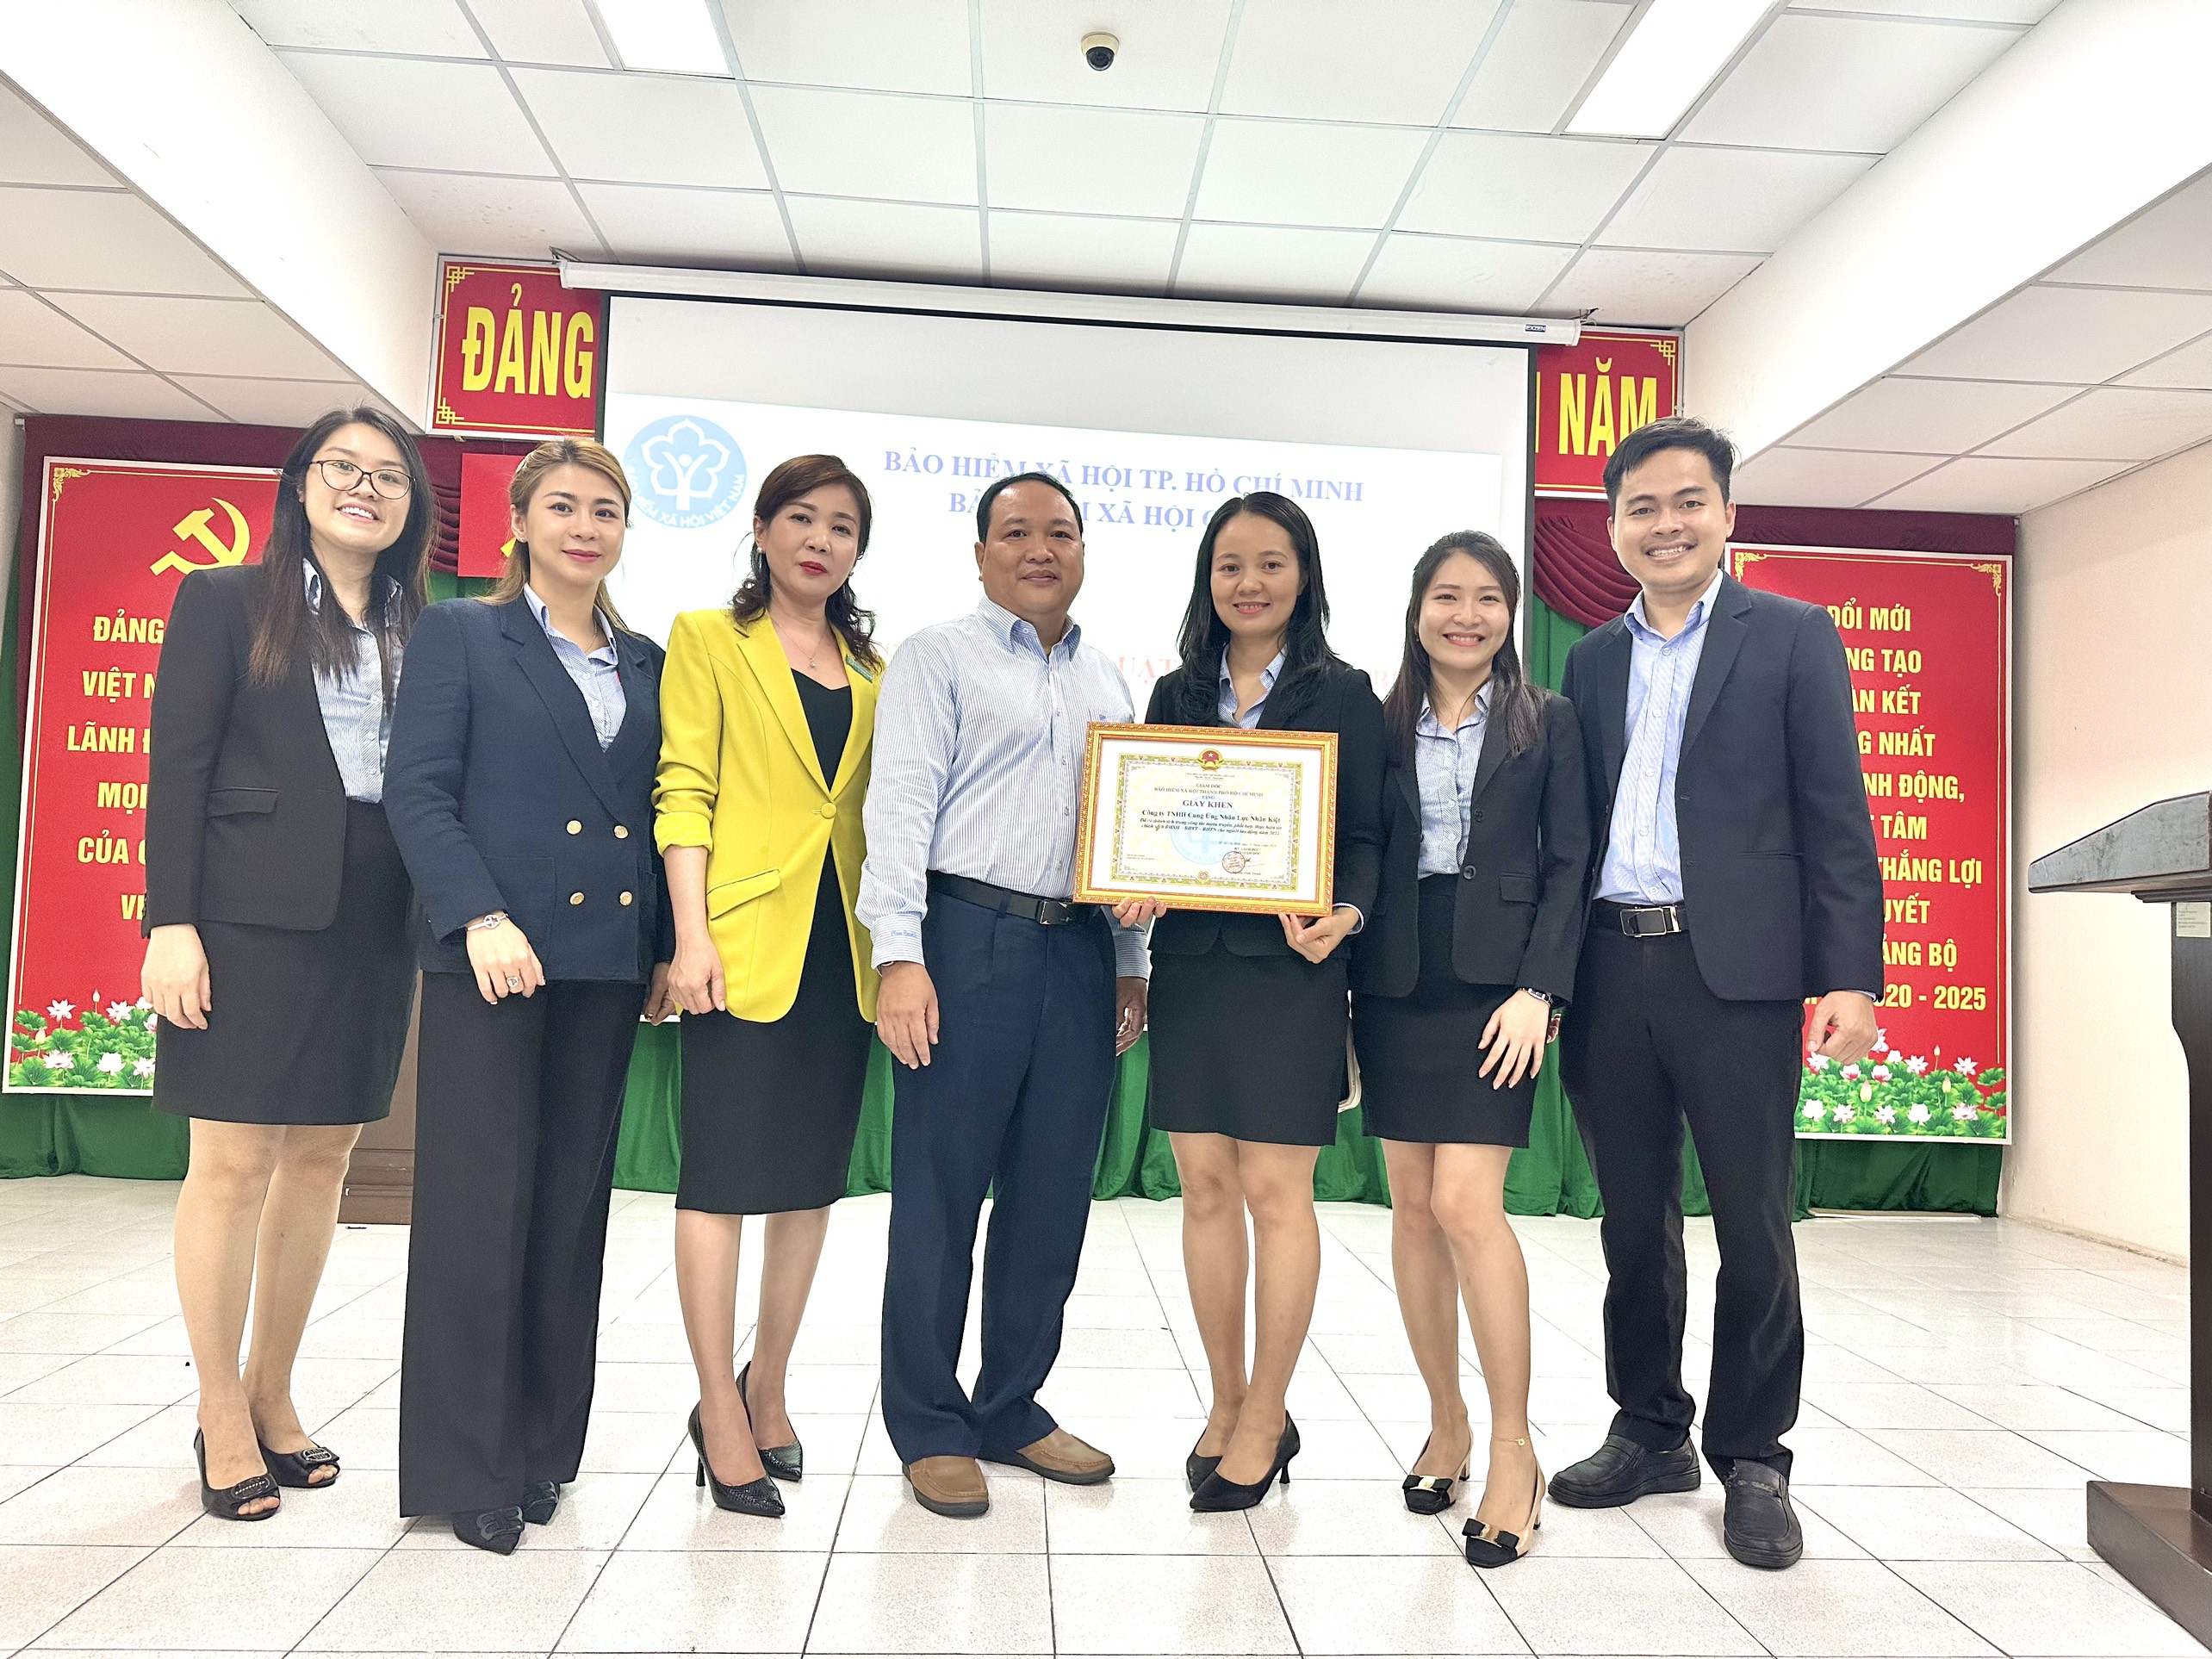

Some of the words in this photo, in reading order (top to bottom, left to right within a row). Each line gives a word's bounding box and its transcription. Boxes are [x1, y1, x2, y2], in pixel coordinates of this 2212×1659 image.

[461, 283, 594, 399] ĐẢNG
[1558, 357, 1657, 457] NĂM
[884, 446, 944, 474] BẢO
[1081, 464, 1134, 493] HỘI
[1140, 469, 1177, 490] TP.
[1184, 468, 1226, 494] HỒ
[1233, 472, 1283, 494] CHÍ
[1290, 478, 1365, 501] MINH
[1098, 500, 1136, 525] XÃ
[1143, 505, 1195, 533] HỘI
[93, 608, 165, 644] ĐẢNG
[1869, 603, 1911, 632] MỚI
[1880, 649, 1922, 678] TẠO
[82, 666, 137, 703] VIỆT
[1882, 684, 1922, 715] KẾT
[67, 721, 135, 754] LÃNH
[1879, 724, 1936, 757] NHẤT
[97, 782, 148, 815] MỌI
[1898, 769, 1965, 804] ĐỘNG,
[1880, 811, 1927, 840] TÂM
[78, 829, 130, 864] CỦA
[1948, 857, 1982, 889] LỢI
[1884, 892, 1930, 924] UYẾT
[1882, 933, 1922, 966] ẢNG
[1929, 938, 1958, 972] BỘ
[1933, 985, 1986, 1011] 2025
